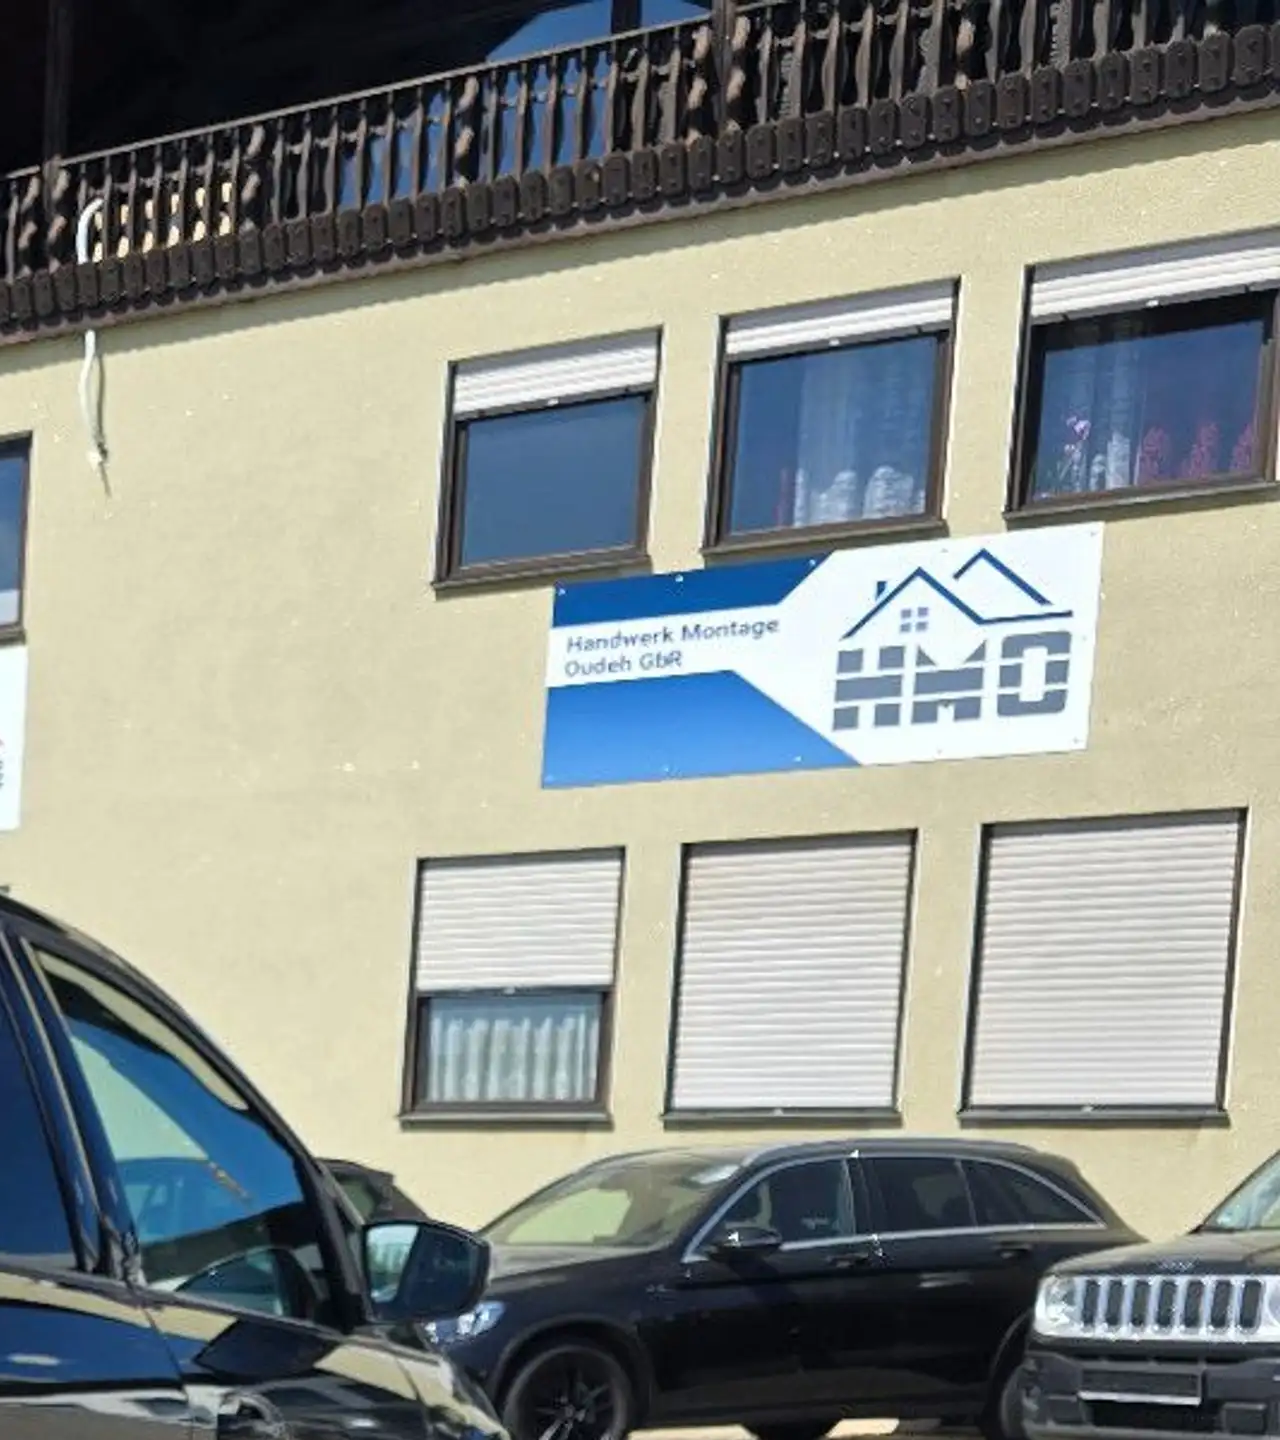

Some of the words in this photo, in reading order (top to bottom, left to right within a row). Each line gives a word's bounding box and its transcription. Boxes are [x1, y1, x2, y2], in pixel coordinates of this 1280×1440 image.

[566, 626, 674, 653] Handwerk
[681, 618, 780, 641] Montage
[564, 655, 632, 678] Oudeh
[639, 650, 683, 671] GbR
[832, 630, 1072, 732] HMO
